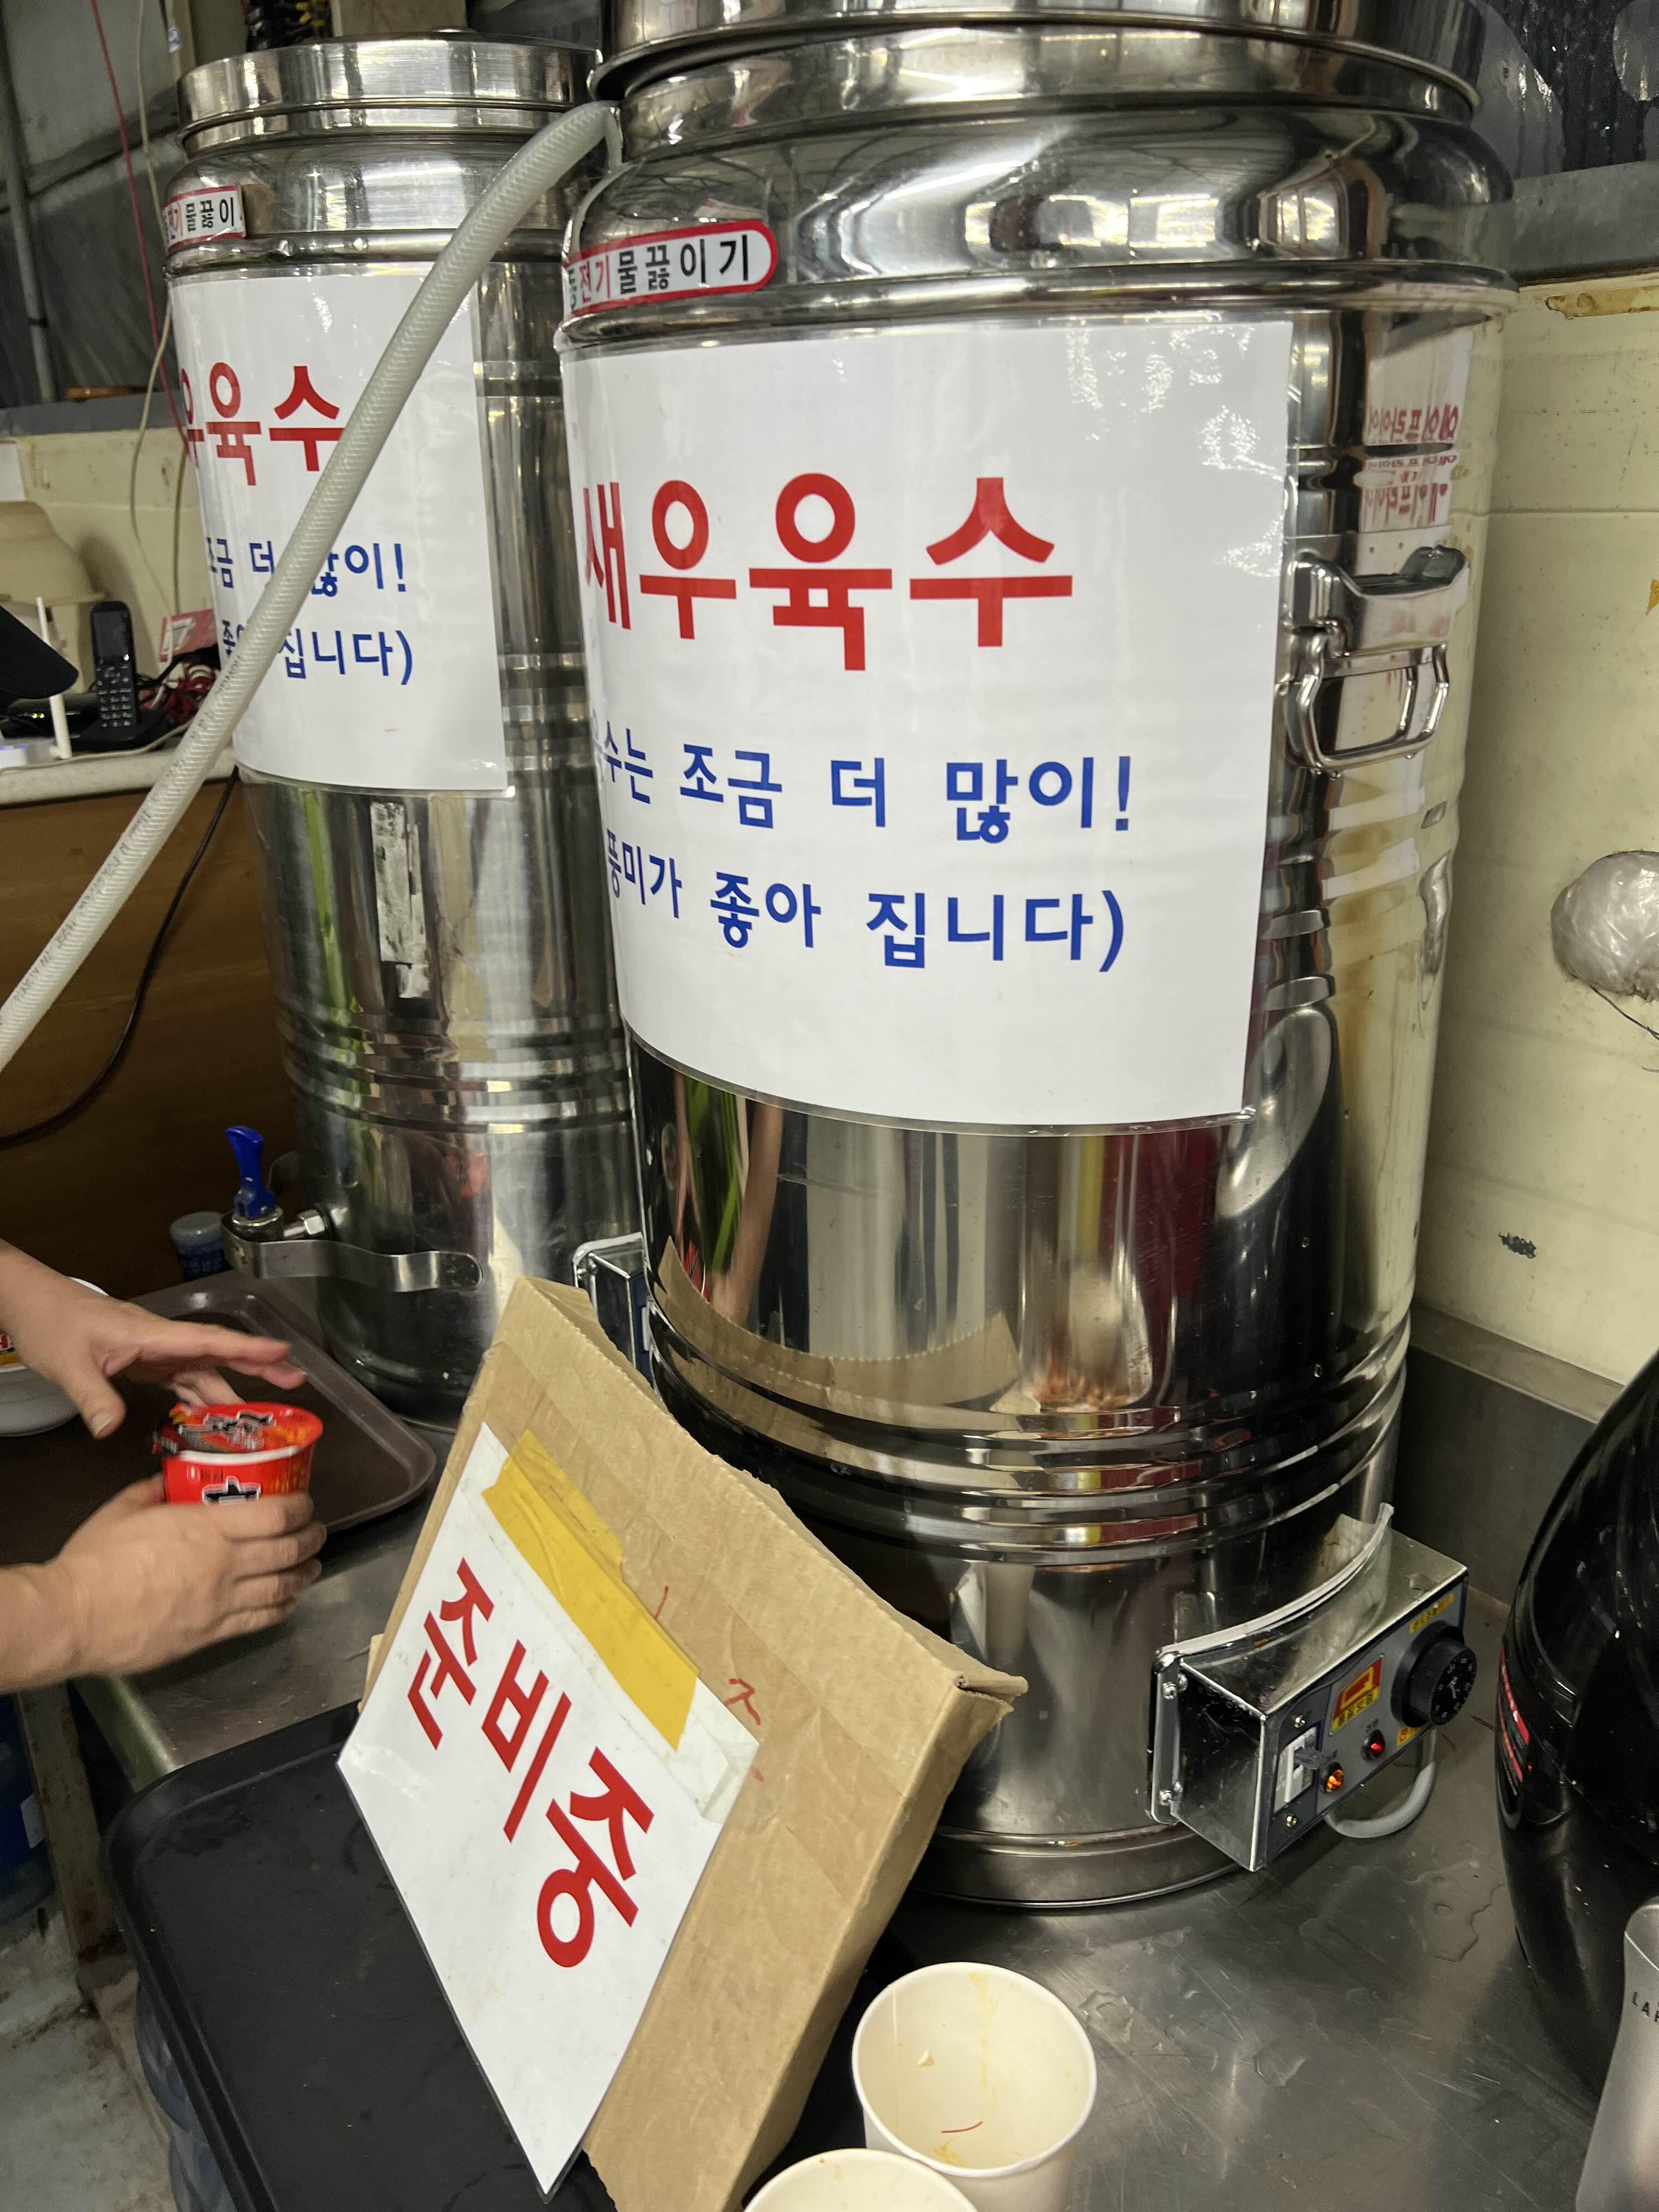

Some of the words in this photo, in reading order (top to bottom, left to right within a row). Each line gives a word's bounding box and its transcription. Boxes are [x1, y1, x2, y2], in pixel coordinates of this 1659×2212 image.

[583, 473, 1073, 672] 새우육수
[679, 744, 782, 829] 조금
[830, 757, 886, 828] 더
[945, 755, 1132, 845] 많이!
[710, 871, 822, 950] 좋아
[865, 889, 1125, 973] 집니다)
[407, 1557, 655, 1968] 준비중
